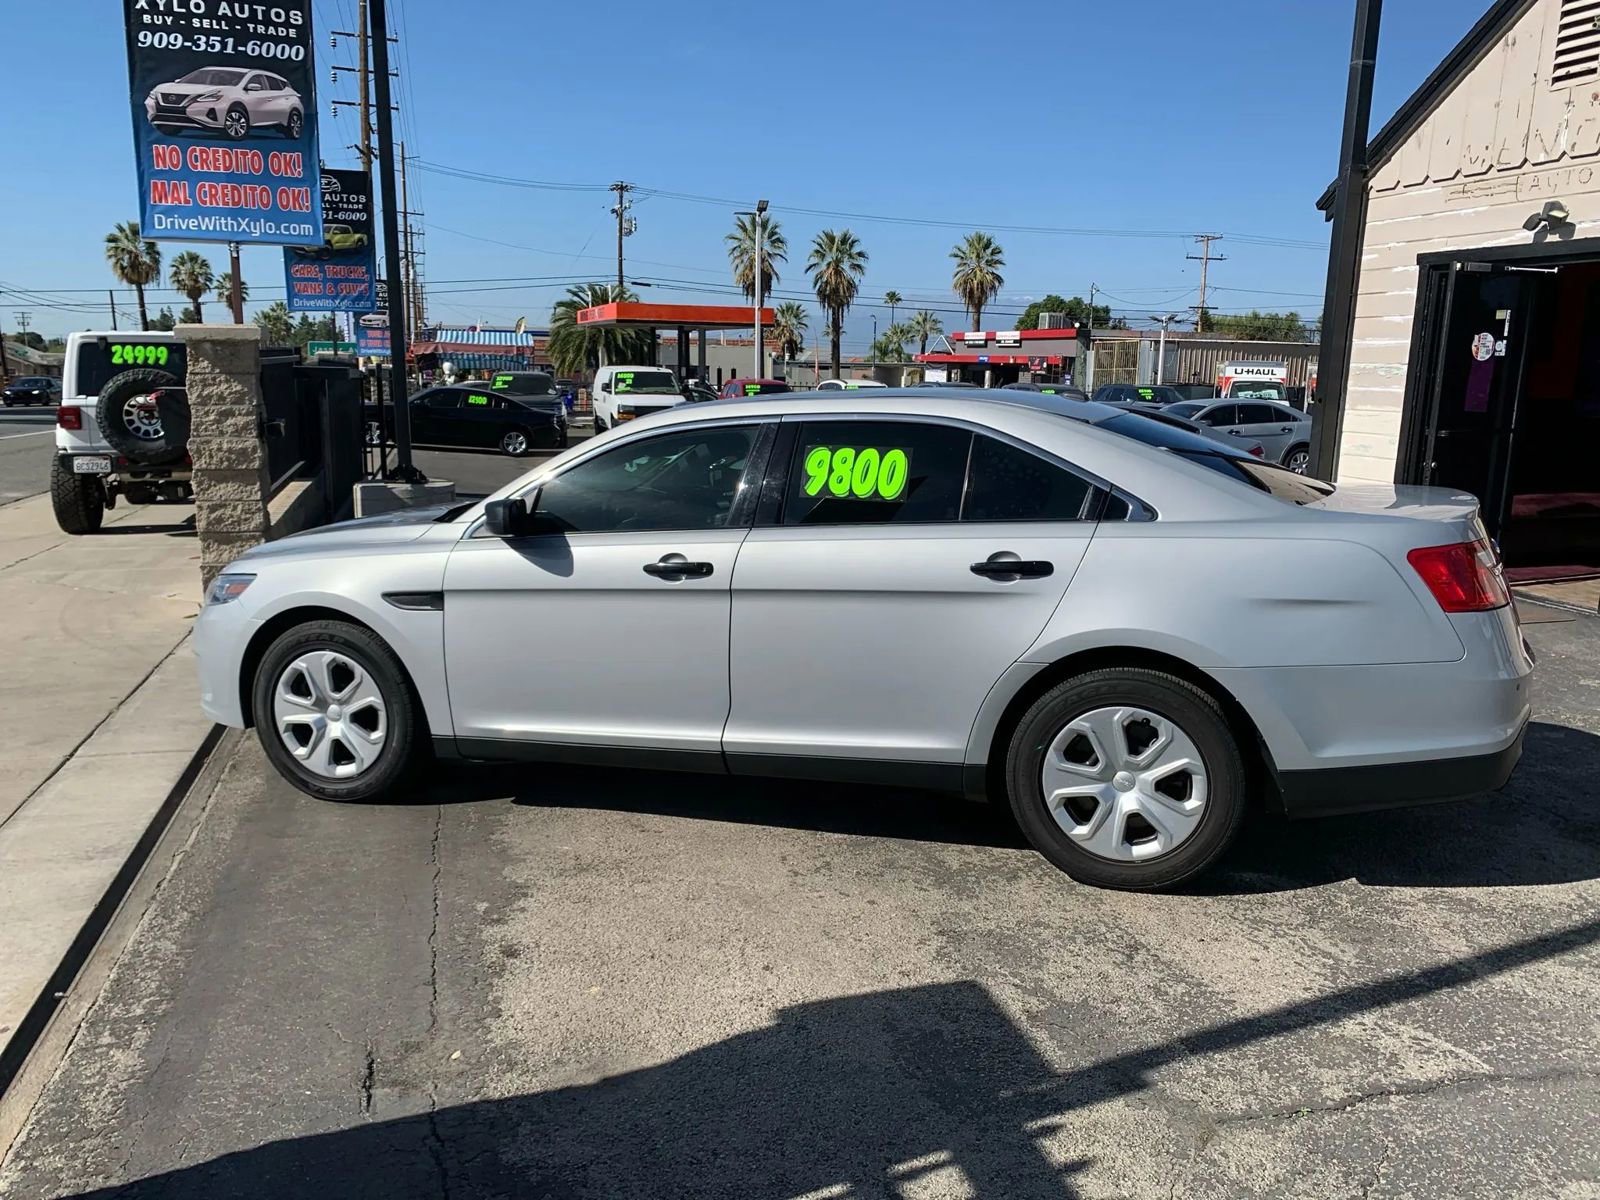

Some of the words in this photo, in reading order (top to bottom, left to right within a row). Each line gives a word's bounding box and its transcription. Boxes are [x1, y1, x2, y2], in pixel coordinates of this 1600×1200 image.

[135, 0, 205, 13] XYLO
[218, 1, 303, 25] AUTOS
[143, 14, 173, 25] BUY
[192, 17, 229, 30] SELL
[247, 23, 297, 37] TRADE
[137, 31, 304, 61] 909-351-6000
[153, 144, 181, 170] NO
[187, 146, 263, 175] CREDITO
[268, 151, 303, 178] OK!
[151, 179, 192, 206] MAL
[196, 182, 272, 210] CREDITO
[277, 186, 311, 213] OK!
[324, 193, 366, 203] AUTOS
[154, 214, 313, 237] DriveWithXylo.com
[291, 264, 323, 281] CARS,
[325, 265, 369, 281] TRUCKS,
[293, 281, 323, 295] VANS
[326, 282, 335, 295] &
[111, 345, 168, 365] 24999
[1234, 367, 1277, 376] U-HAUL
[804, 446, 908, 500] 9800
